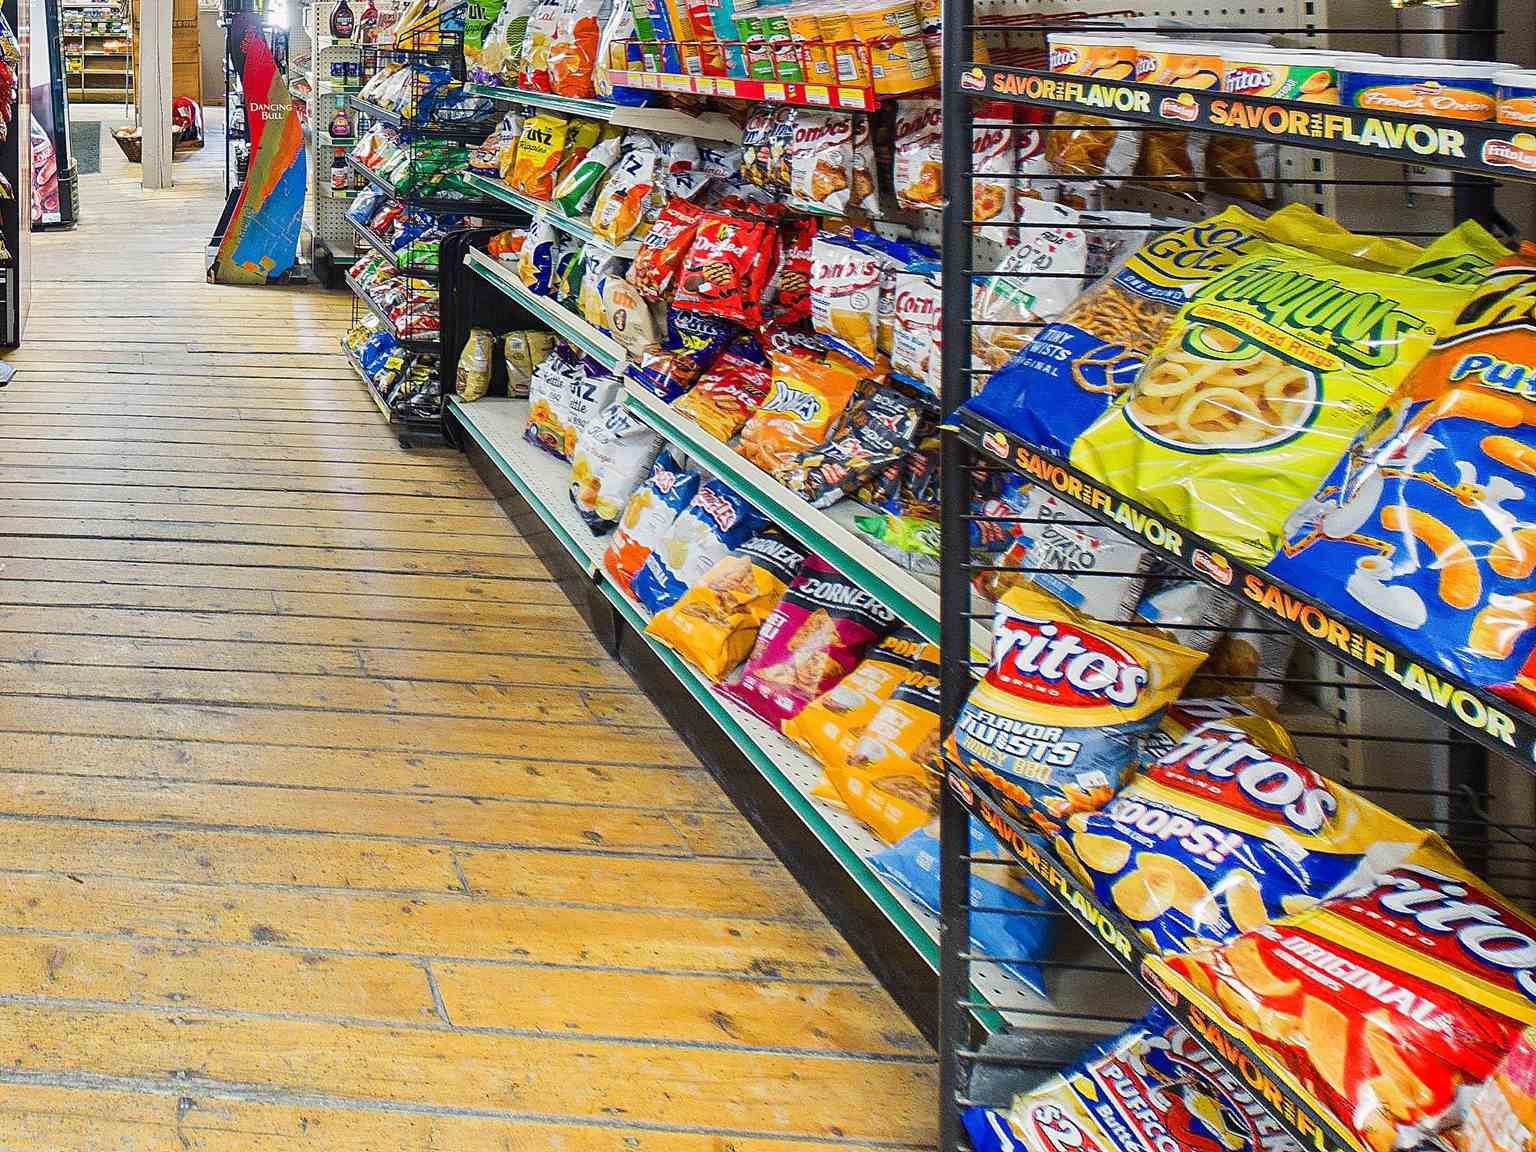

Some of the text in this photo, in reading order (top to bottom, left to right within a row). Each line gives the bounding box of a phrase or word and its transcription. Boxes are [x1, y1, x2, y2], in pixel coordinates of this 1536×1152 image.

[250, 102, 293, 112] DANCING
[261, 110, 284, 120] BULL
[993, 72, 1057, 98] SAVOR
[1064, 82, 1150, 112] FLAVOR
[1209, 99, 1310, 137] SAVOR
[1323, 107, 1465, 158] FLAVOR
[1289, 334, 1338, 369] Rings
[873, 393, 907, 413] BOLD
[1016, 447, 1083, 499] SAVOR
[1091, 490, 1183, 554] FLAVOR
[1243, 574, 1353, 649] SAVOR
[1365, 645, 1518, 748] FLAVOR
[1285, 935, 1452, 1034] ORIGINAL
[1188, 1005, 1280, 1101] SAVOR
[1104, 1065, 1180, 1152] PUFFCO
